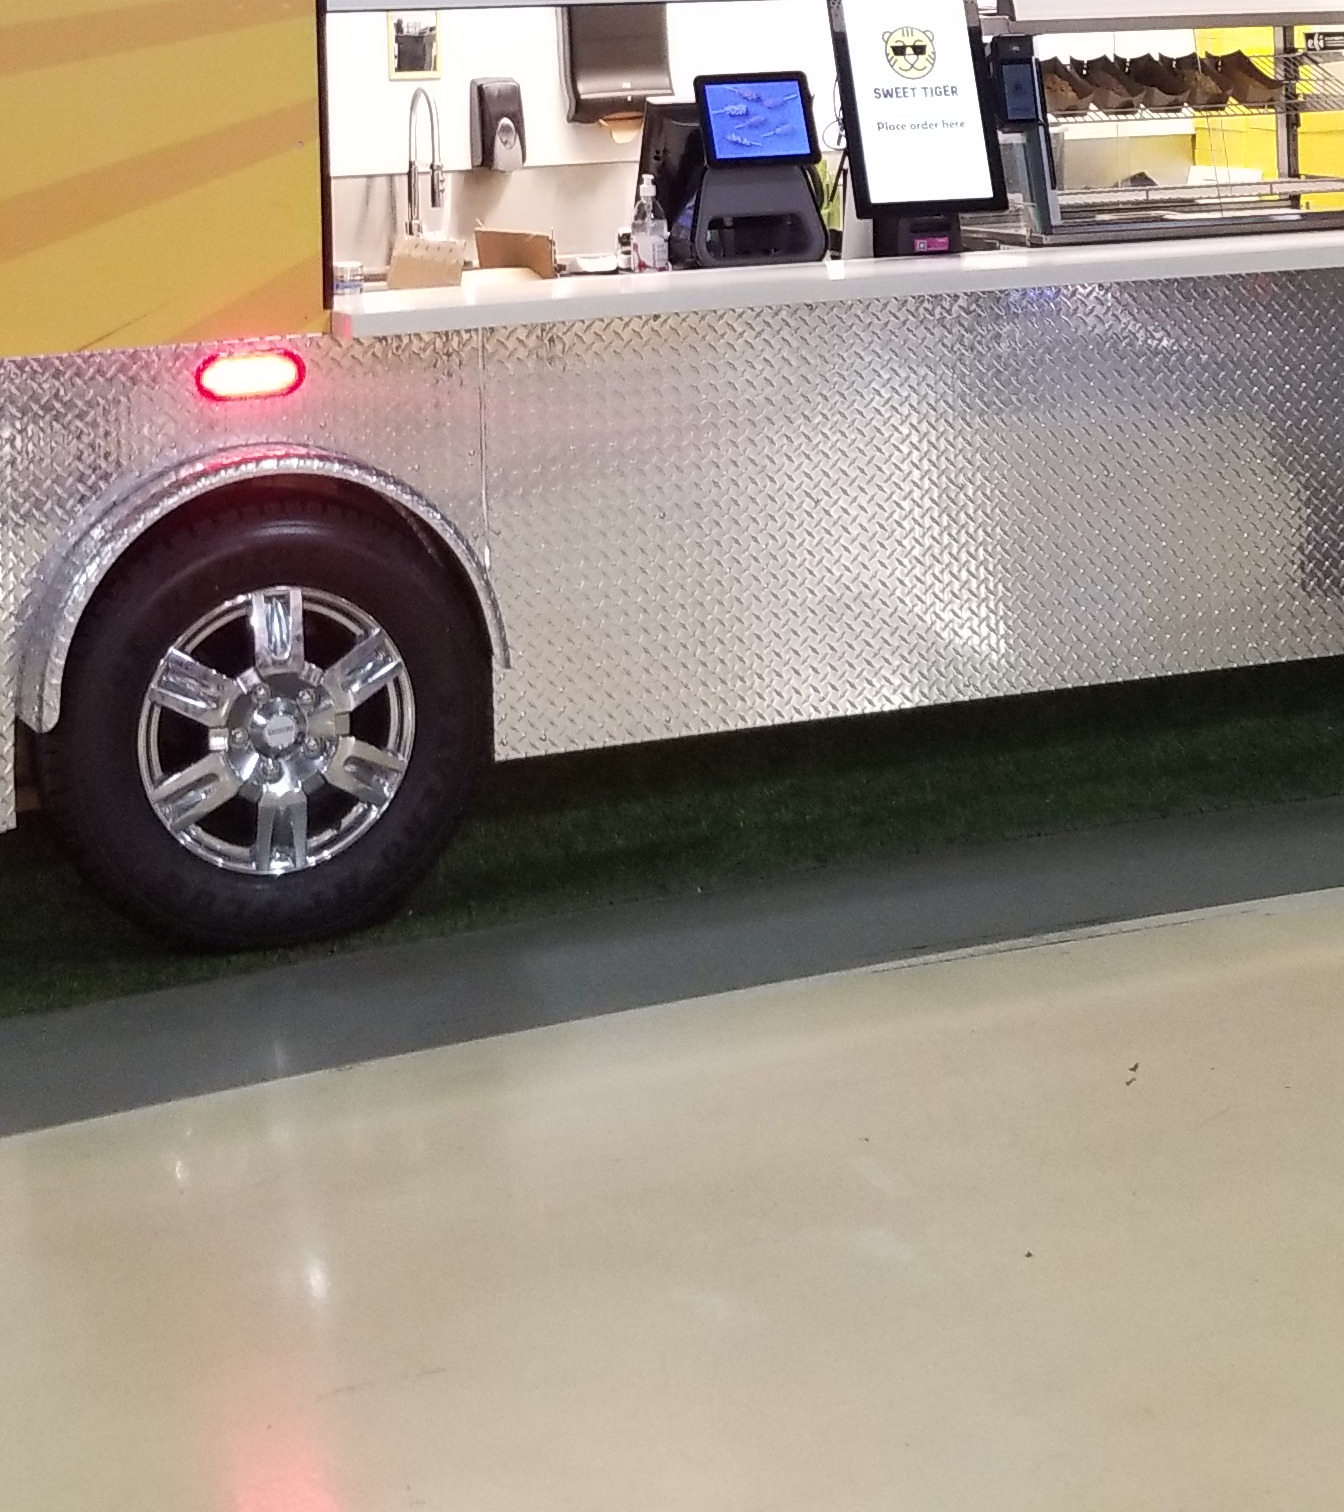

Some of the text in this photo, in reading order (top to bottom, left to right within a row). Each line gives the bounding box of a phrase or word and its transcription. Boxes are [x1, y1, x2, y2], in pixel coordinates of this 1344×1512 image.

[873, 84, 959, 100] SWEET TIGER
[876, 119, 965, 132] Place order here
